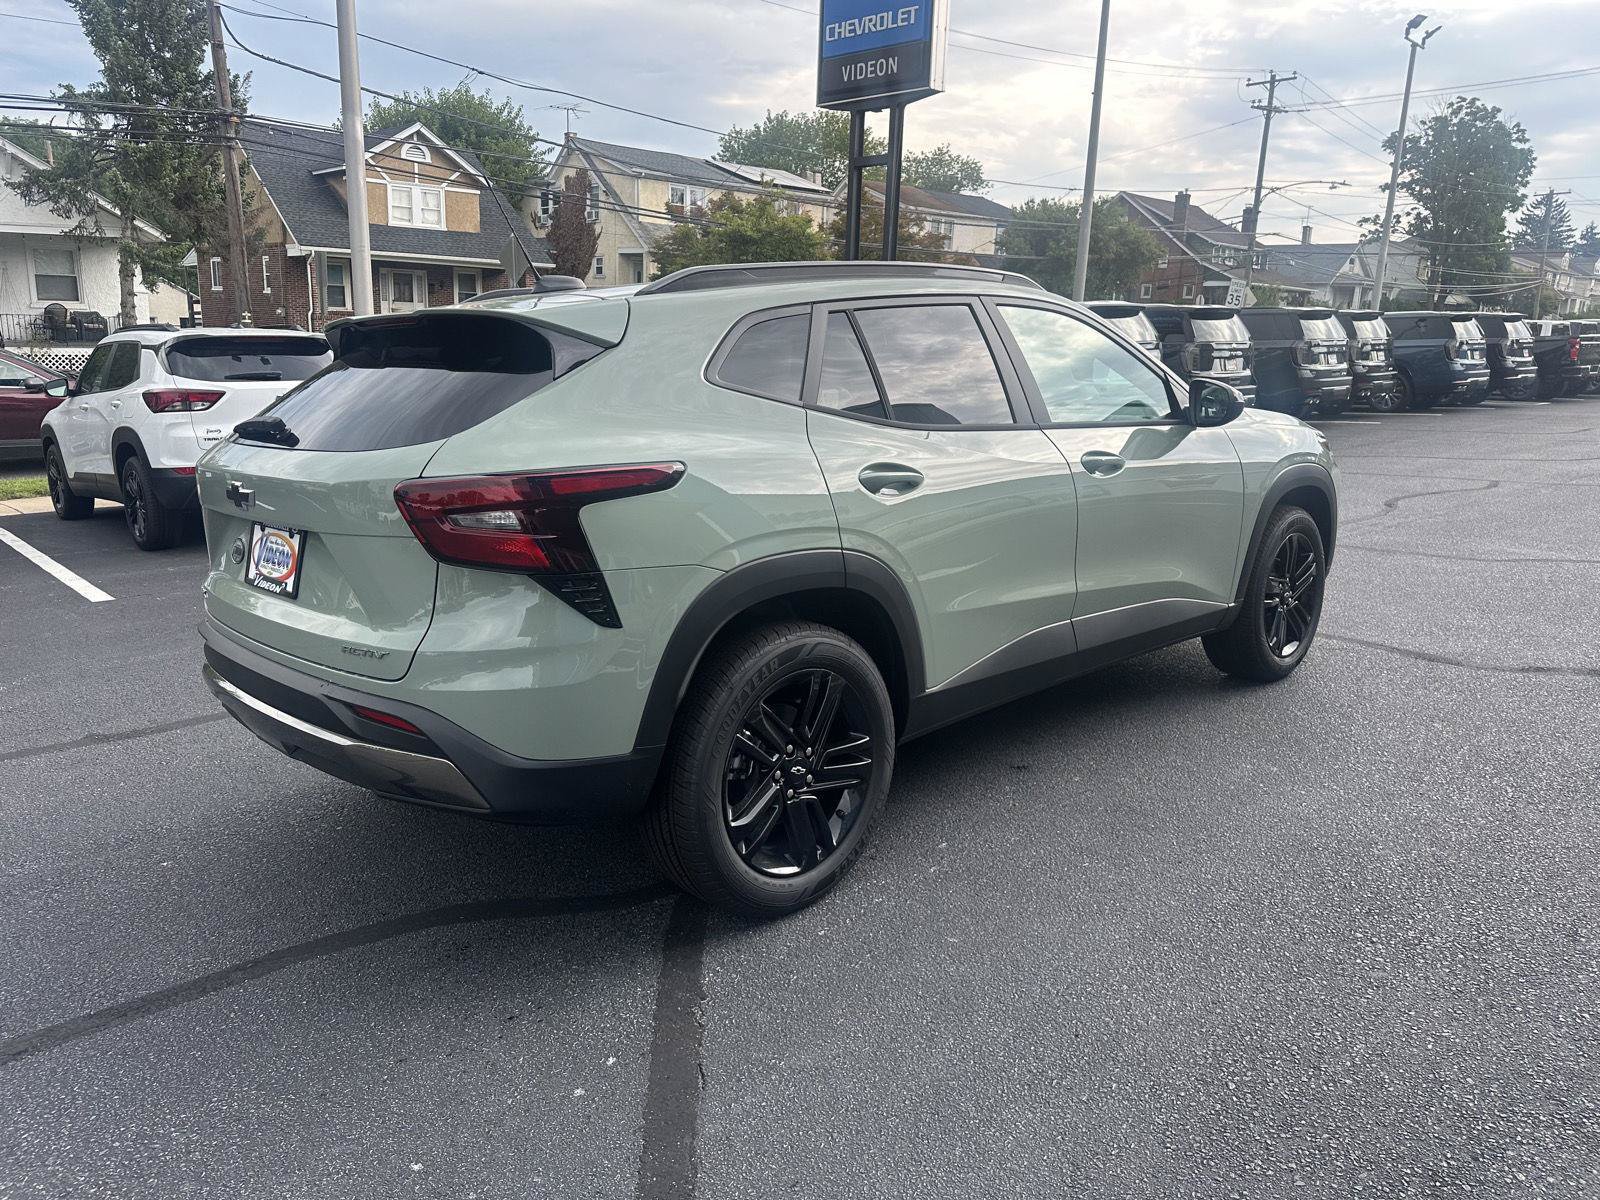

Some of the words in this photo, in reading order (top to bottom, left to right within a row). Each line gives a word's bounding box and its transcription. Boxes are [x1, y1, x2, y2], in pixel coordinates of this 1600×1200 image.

[826, 5, 919, 42] CHEVROLET
[842, 56, 898, 82] VIDEON
[1227, 293, 1241, 306] 35
